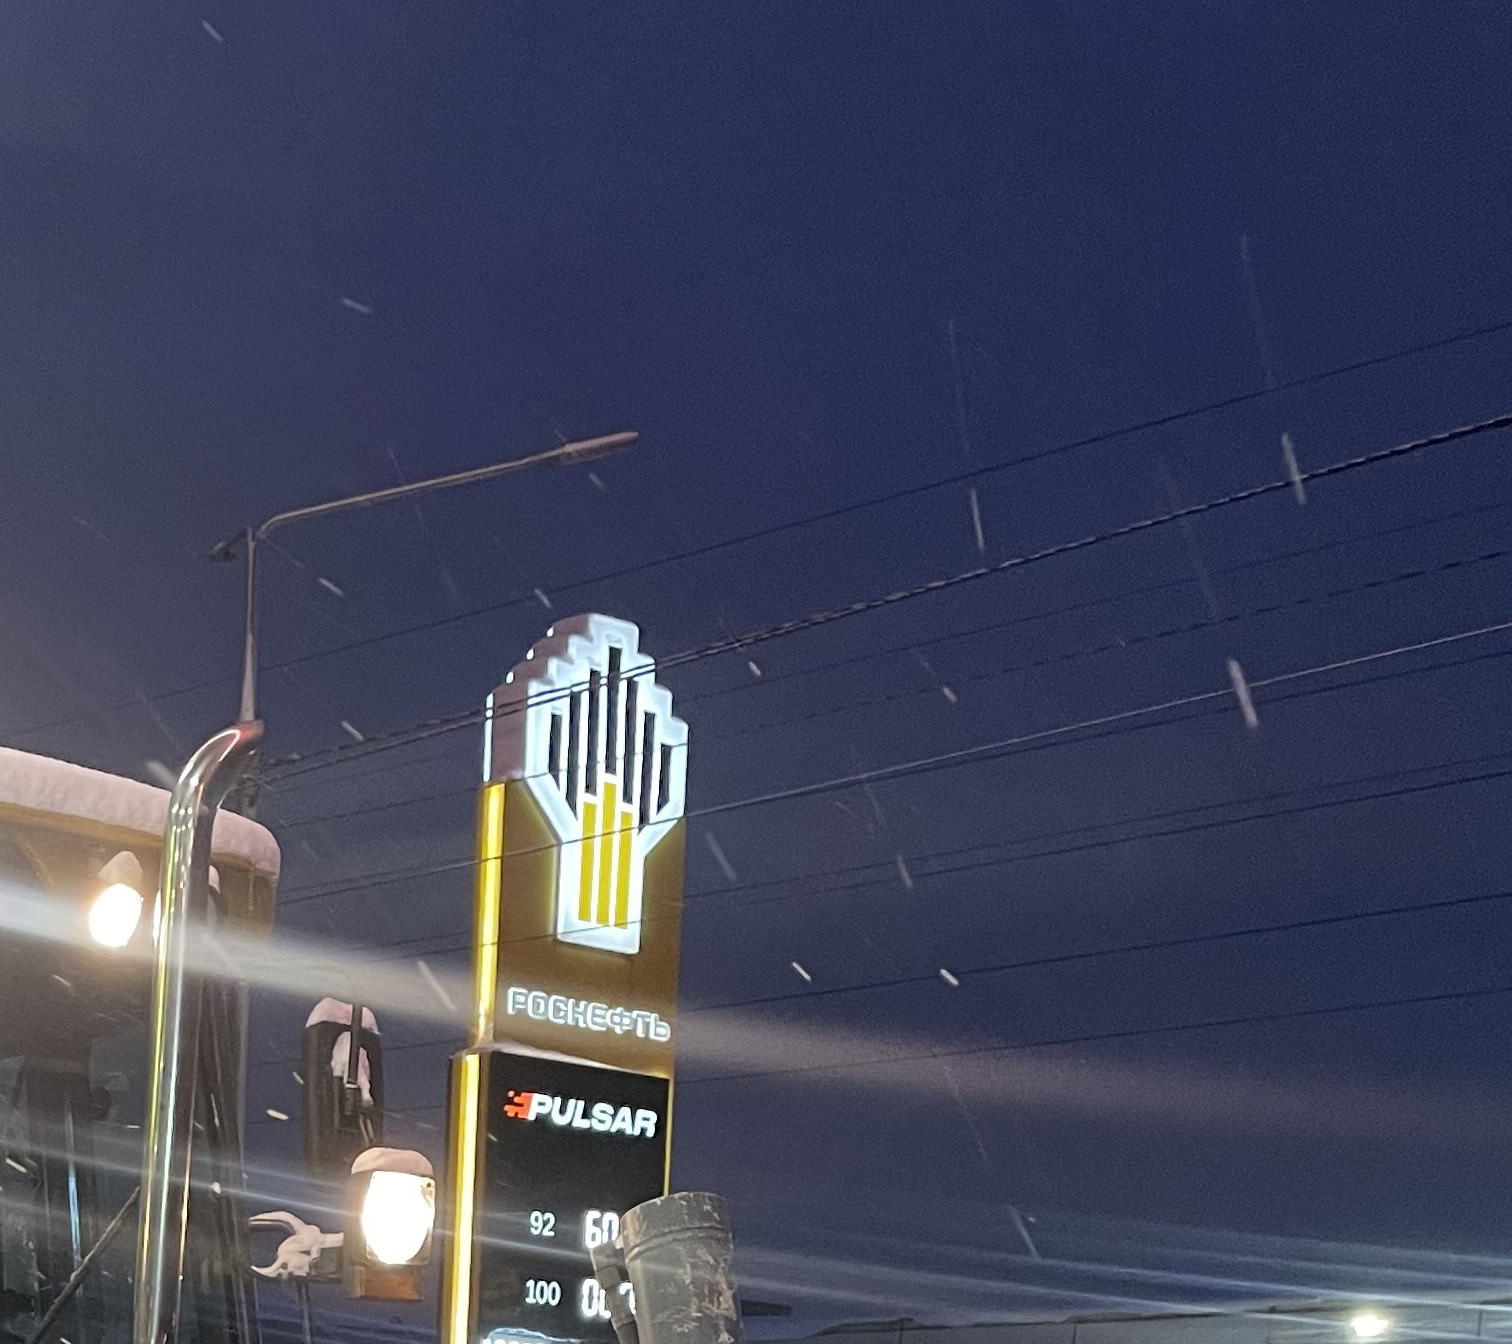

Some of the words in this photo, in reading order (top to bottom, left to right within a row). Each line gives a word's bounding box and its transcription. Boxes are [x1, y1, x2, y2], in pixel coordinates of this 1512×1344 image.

[507, 986, 672, 1042] РОСНЕФТЬ
[527, 1092, 658, 1138] PULSAR
[529, 1210, 555, 1236] 92
[525, 1279, 561, 1306] 100
